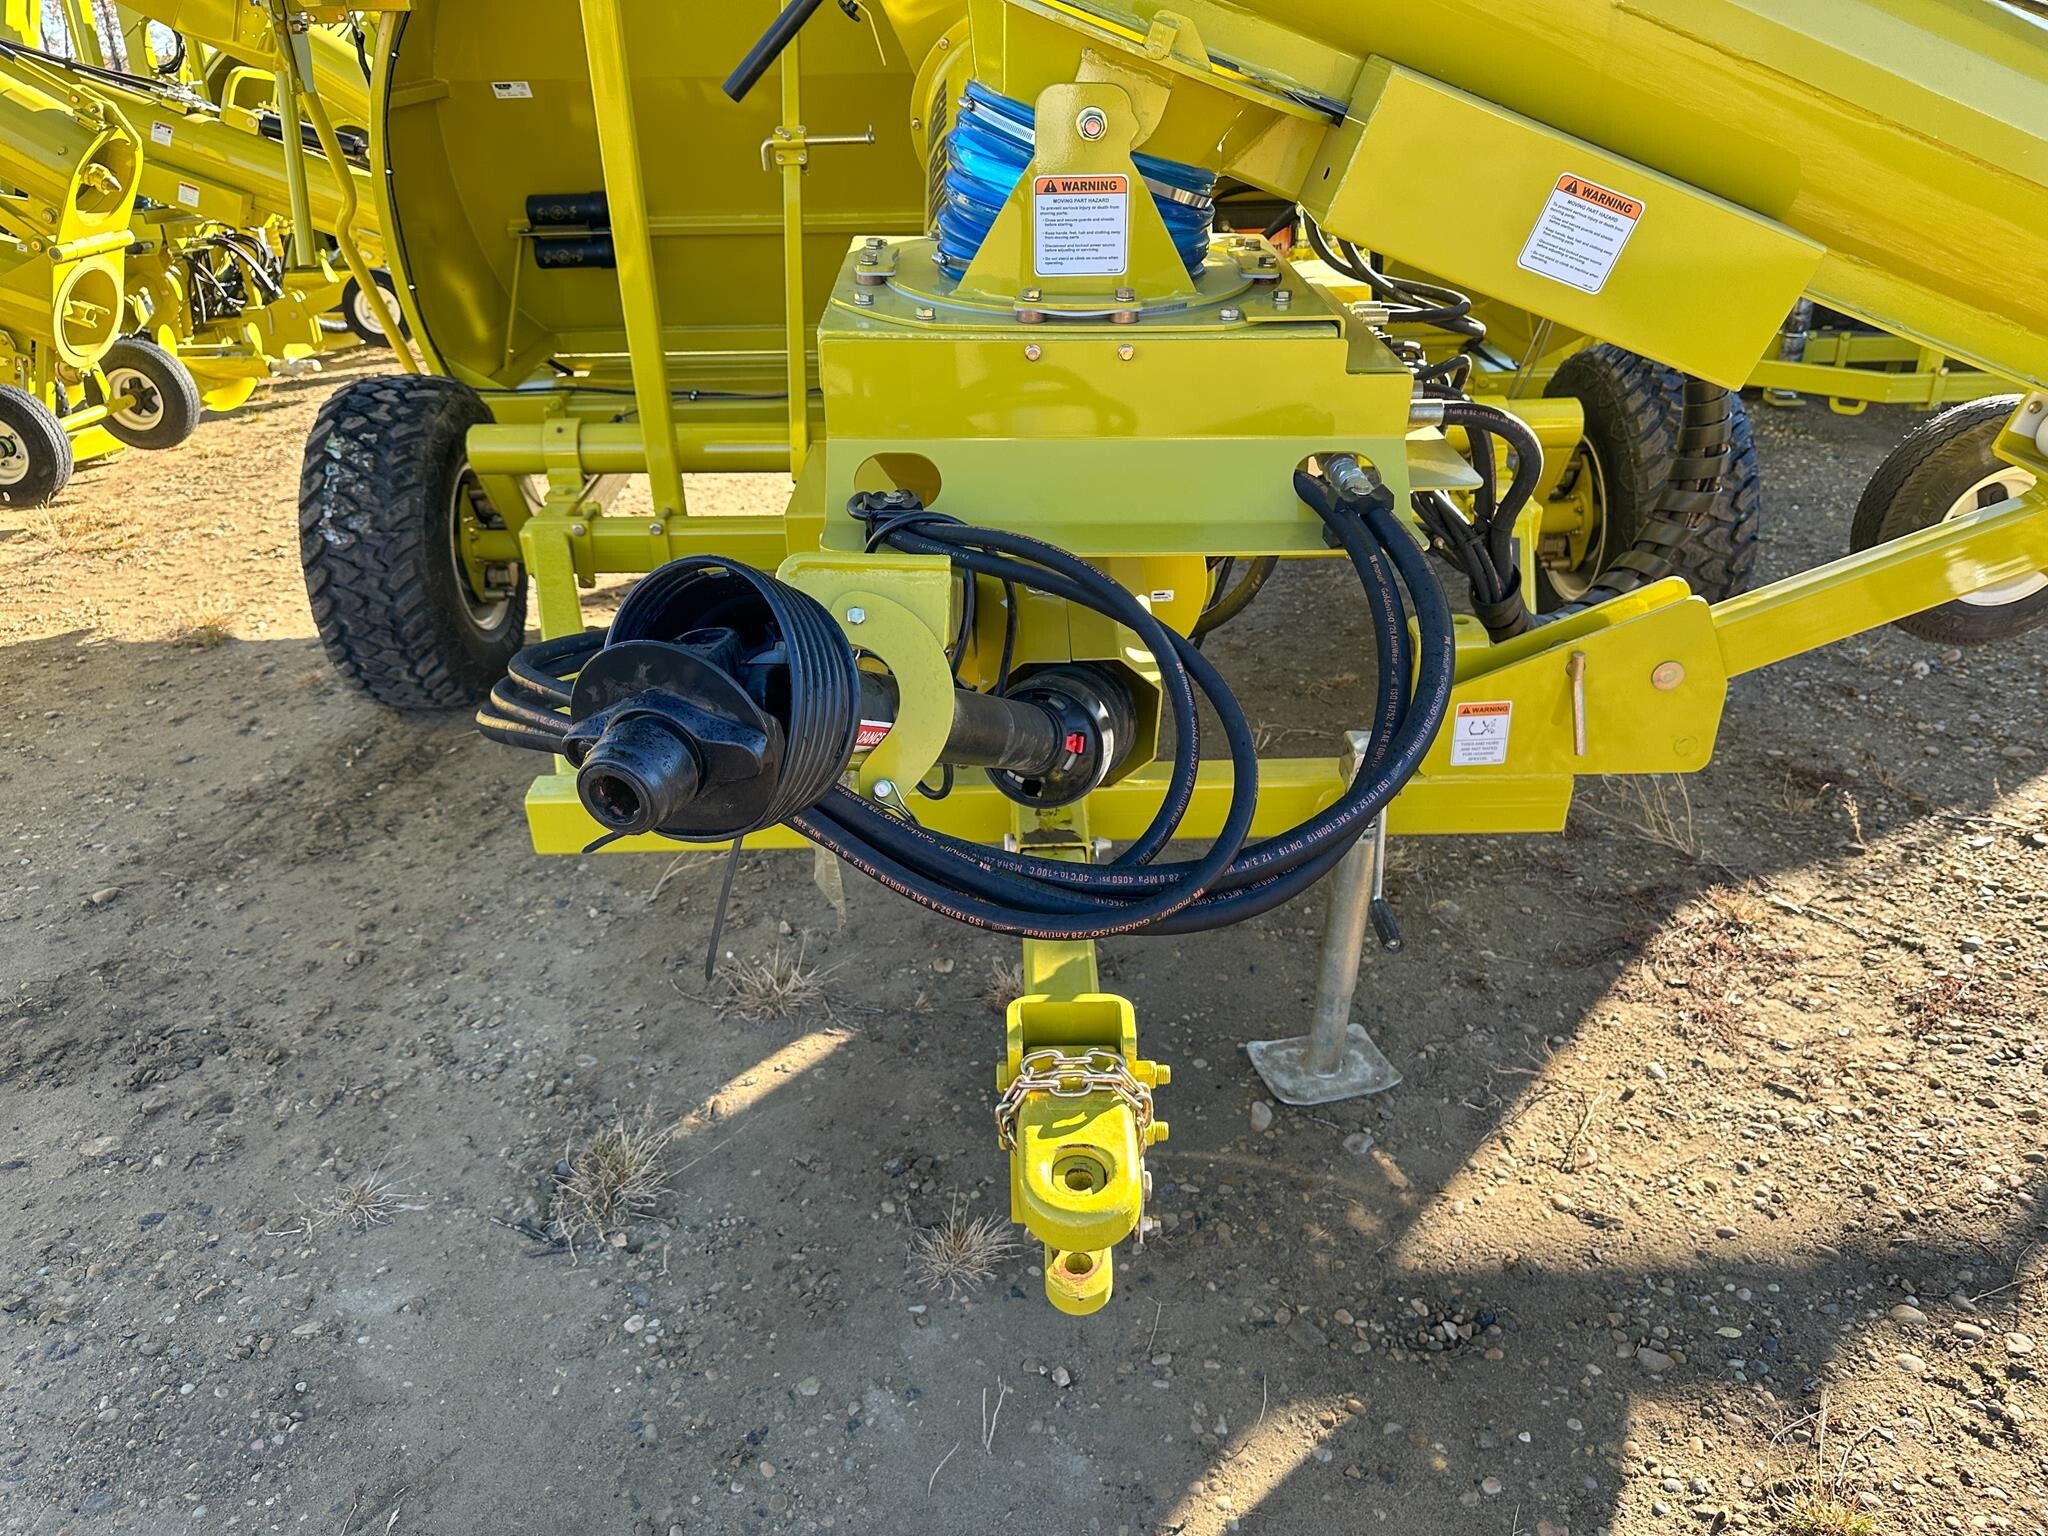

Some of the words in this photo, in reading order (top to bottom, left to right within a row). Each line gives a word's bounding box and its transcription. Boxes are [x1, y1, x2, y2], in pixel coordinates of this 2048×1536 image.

[1061, 181, 1117, 191] WARNING
[1582, 186, 1632, 214] WARNING
[1567, 200, 1586, 210] MOVING
[1599, 212, 1618, 222] HAZARD
[1390, 688, 1398, 702] ISO
[1382, 728, 1393, 744] SAE
[1377, 778, 1390, 792] ISO
[1336, 812, 1351, 827] SAE
[808, 828, 822, 840] WP
[1306, 822, 1336, 844] 100R19
[853, 857, 864, 868] 12
[997, 860, 1022, 872] MSHA
[864, 866, 876, 877] DN
[880, 874, 910, 896] 100R19
[1112, 875, 1134, 884] 4060
[912, 890, 928, 906] SAE
[931, 901, 967, 921] 18752-A
[968, 916, 984, 927] ISO
[1023, 928, 1069, 940] AntiWear
